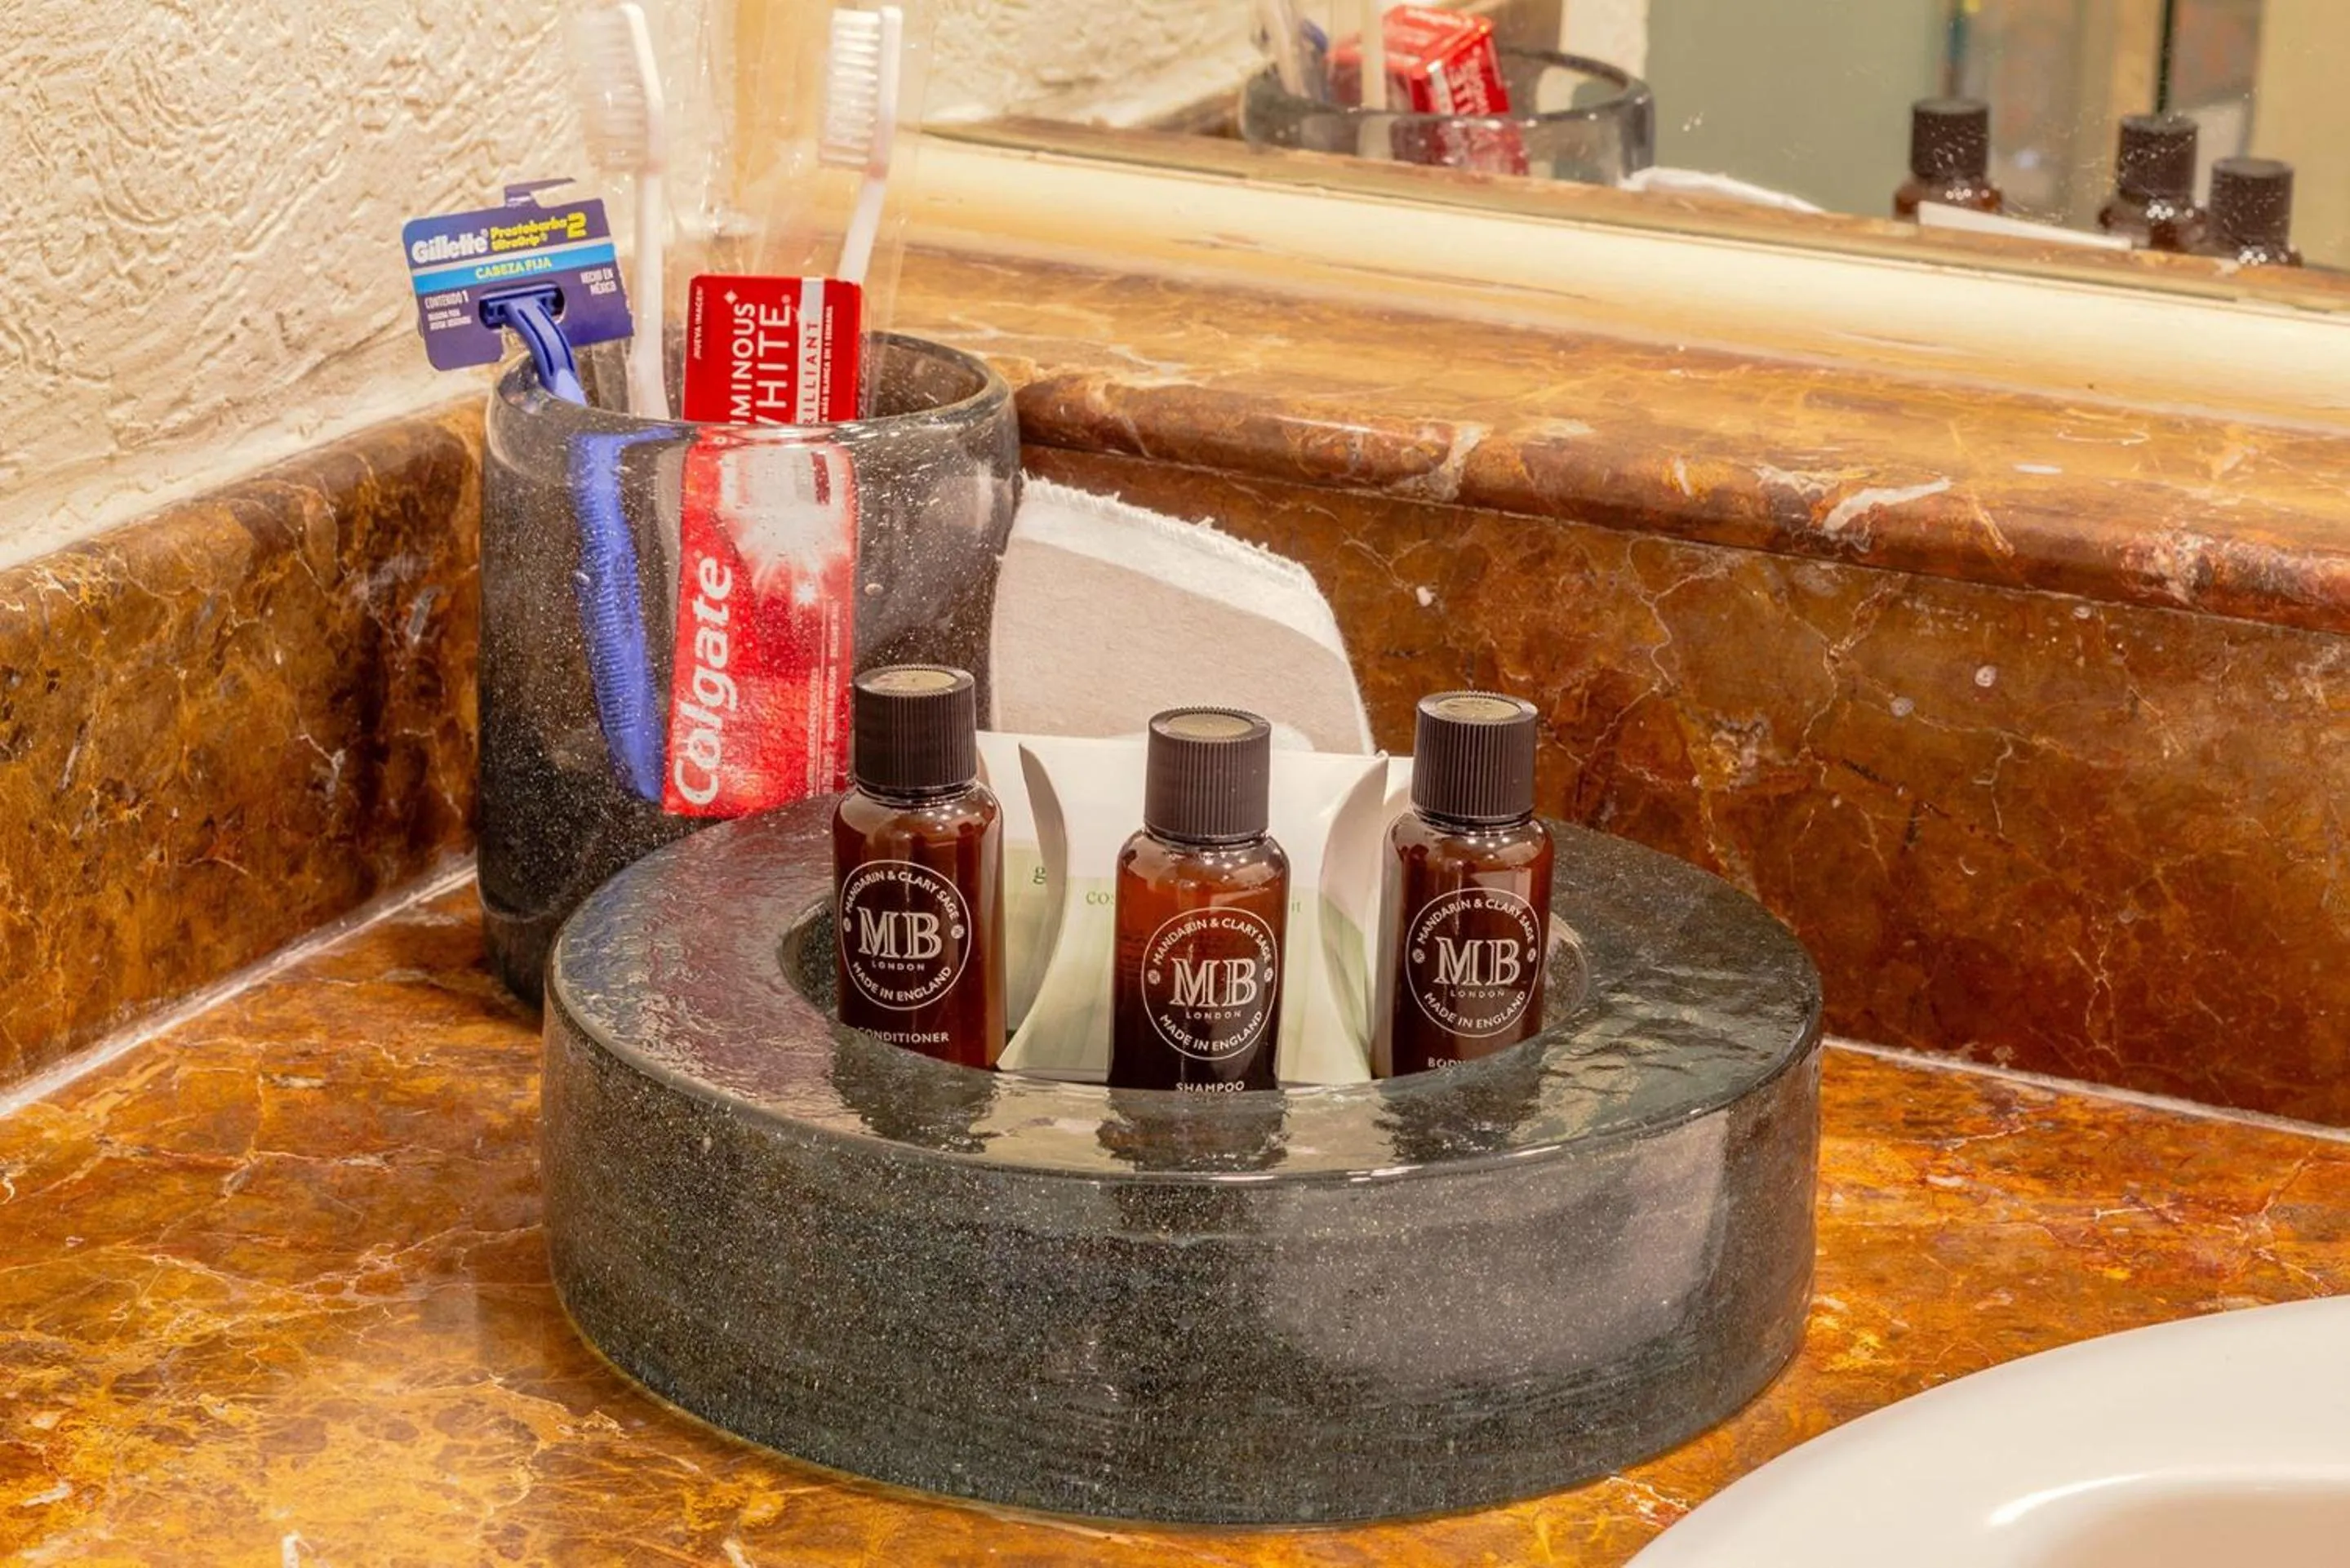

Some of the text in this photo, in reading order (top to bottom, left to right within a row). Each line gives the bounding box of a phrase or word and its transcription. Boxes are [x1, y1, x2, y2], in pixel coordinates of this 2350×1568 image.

[567, 212, 587, 238] 2
[411, 233, 488, 264] Gillette
[475, 257, 552, 279] CABEZA FIJA
[802, 320, 819, 424] RILLIANT
[673, 557, 737, 805] Colgate
[845, 870, 961, 920] MANDARIN & CLARY SAGE
[856, 906, 943, 959] MB
[1153, 917, 1273, 966] MANDARIN & CLARY SAGE
[1417, 898, 1535, 944] MANDARIN & CLARY SAGE
[871, 960, 926, 971] LONDON
[1432, 935, 1521, 987] MB
[853, 962, 953, 1002] MADE IN ENGLAND
[1169, 957, 1258, 1008] MB
[1450, 988, 1506, 1000] LONDON
[1186, 1010, 1242, 1020] LONDON
[1424, 989, 1526, 1030] MADE IN ENGLAND
[1160, 1010, 1263, 1052] MADE IN ENGLAND
[1428, 1056, 1467, 1068] BOD
[1175, 1080, 1246, 1093] SHAMPOO
